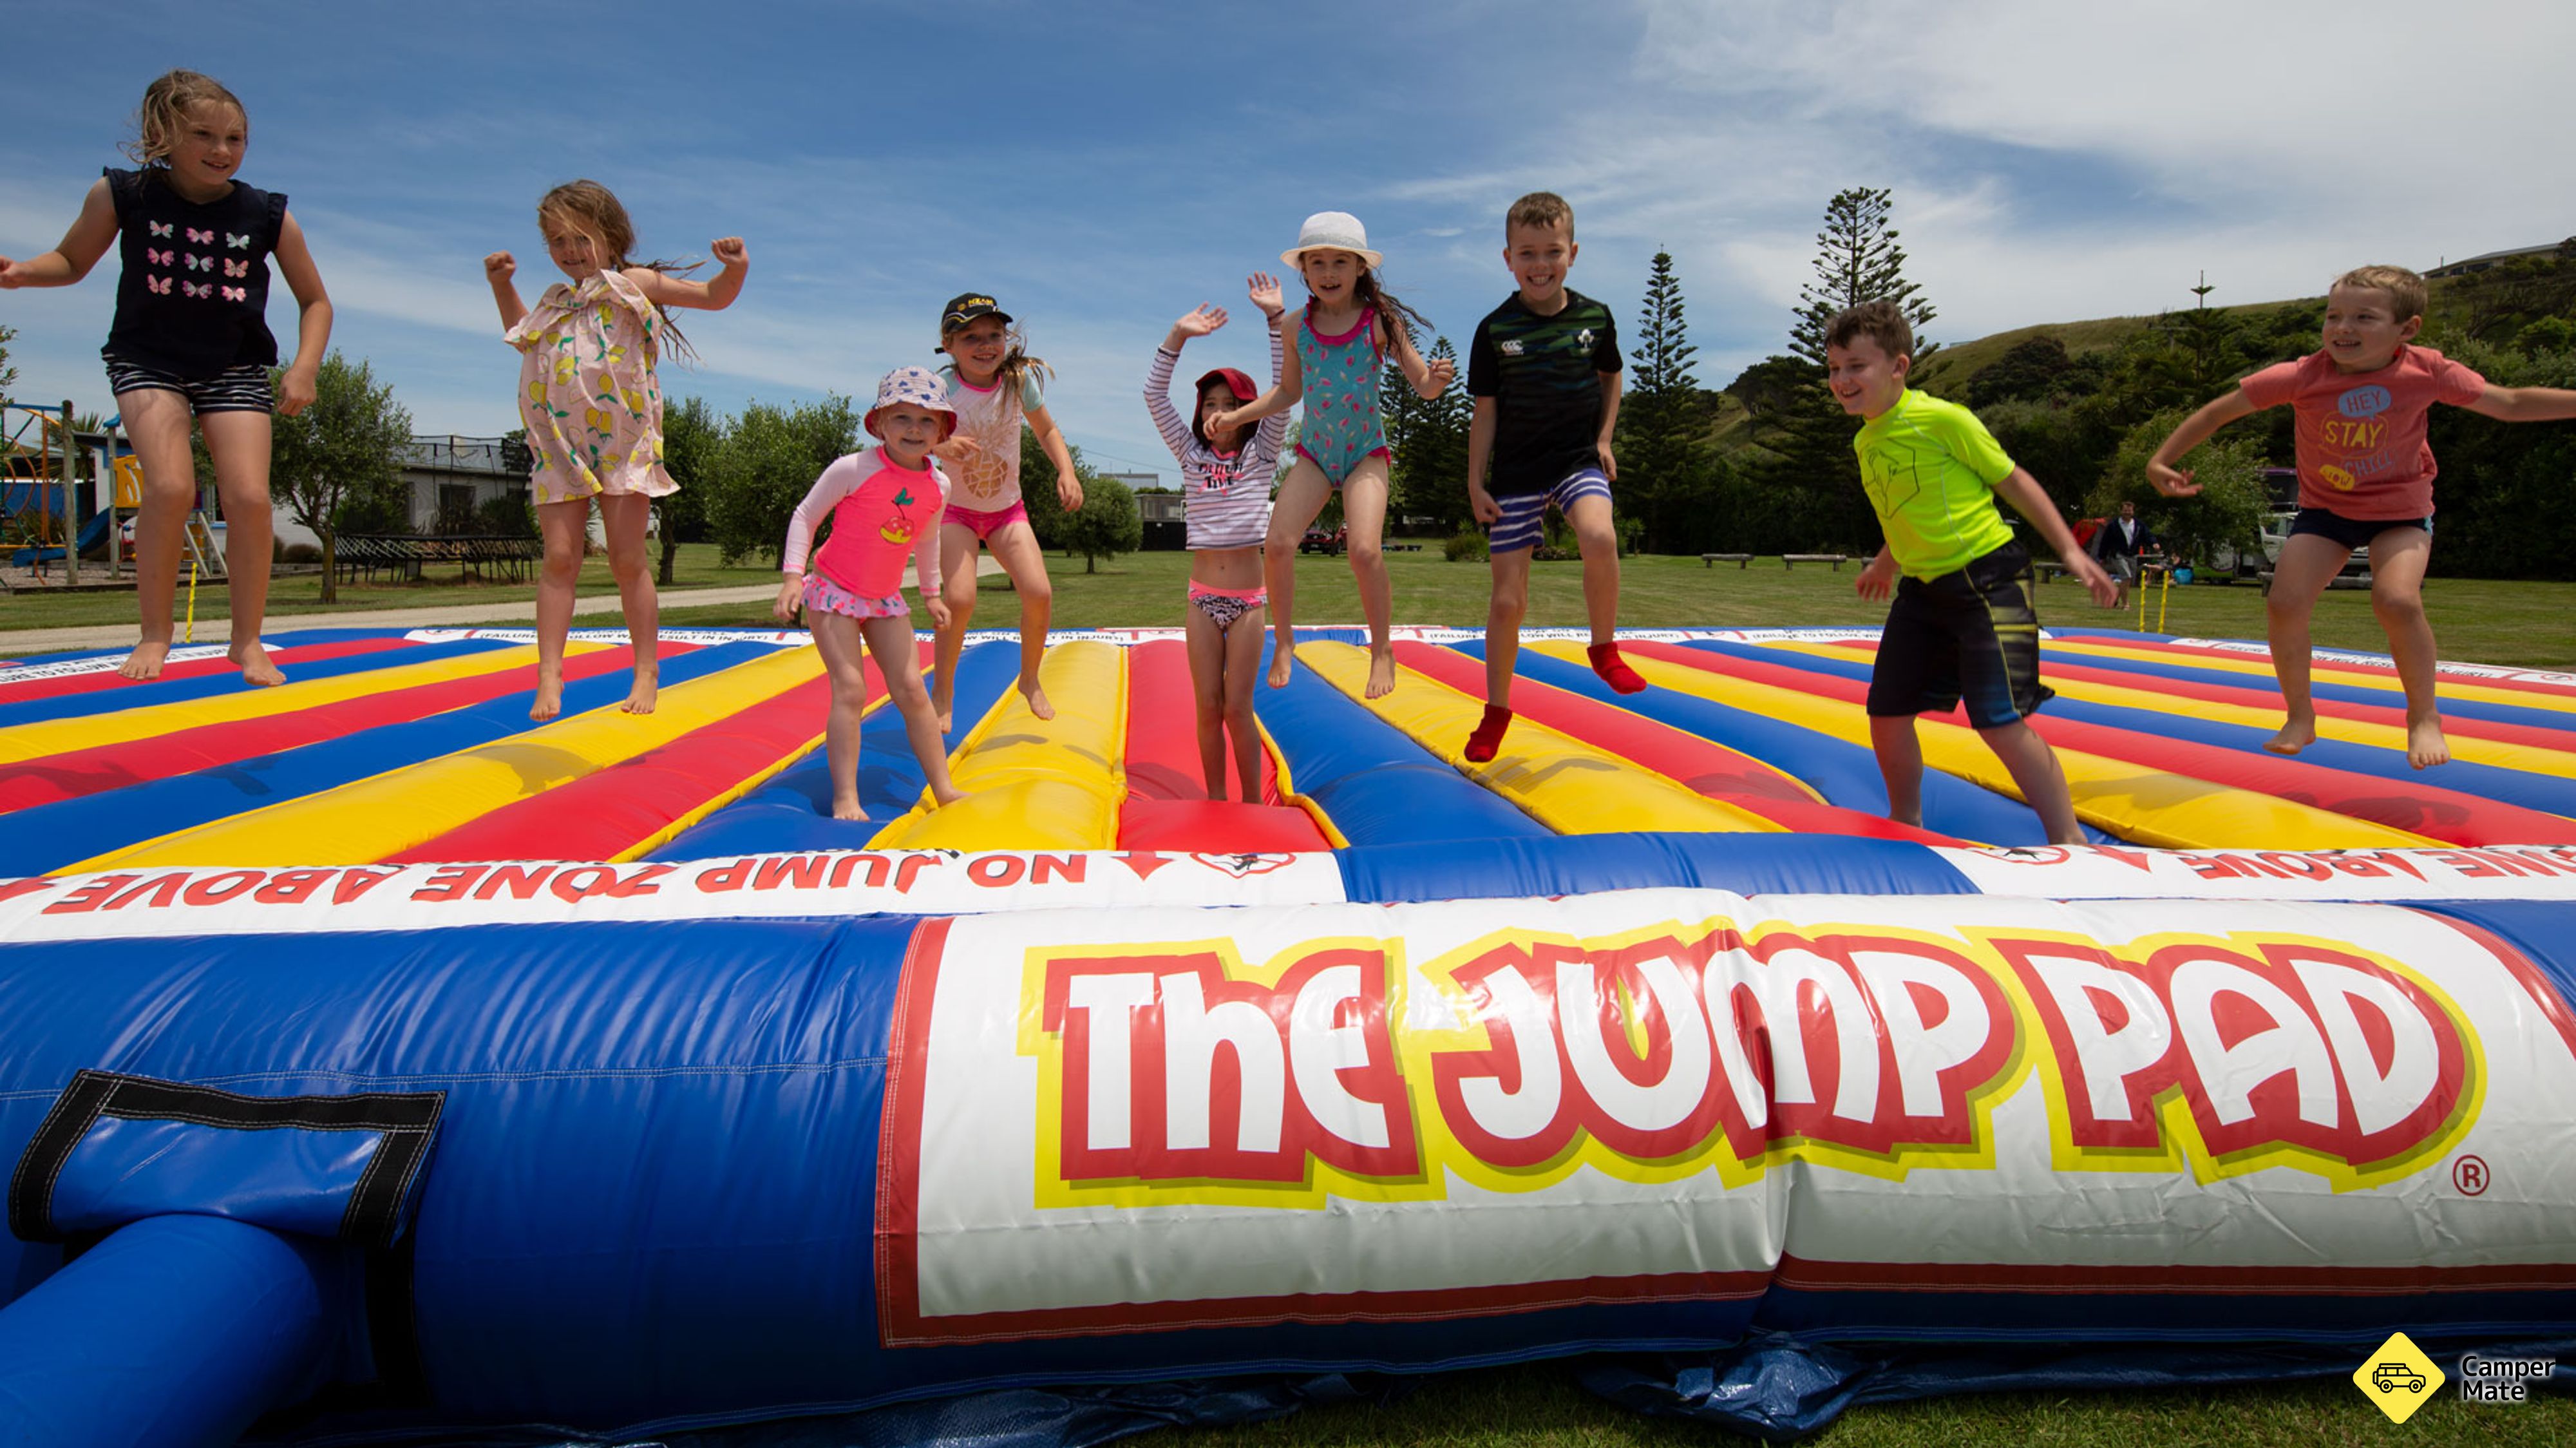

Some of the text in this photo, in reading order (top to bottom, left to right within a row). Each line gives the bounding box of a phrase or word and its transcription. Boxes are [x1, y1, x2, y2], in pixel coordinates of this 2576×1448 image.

[2346, 391, 2381, 412] HEY
[2325, 421, 2383, 448] STAY
[41, 855, 1086, 914] NO JUMP ZONE ABOVE
[1446, 938, 2003, 1153] JUMP
[2006, 946, 2452, 1151] PAD
